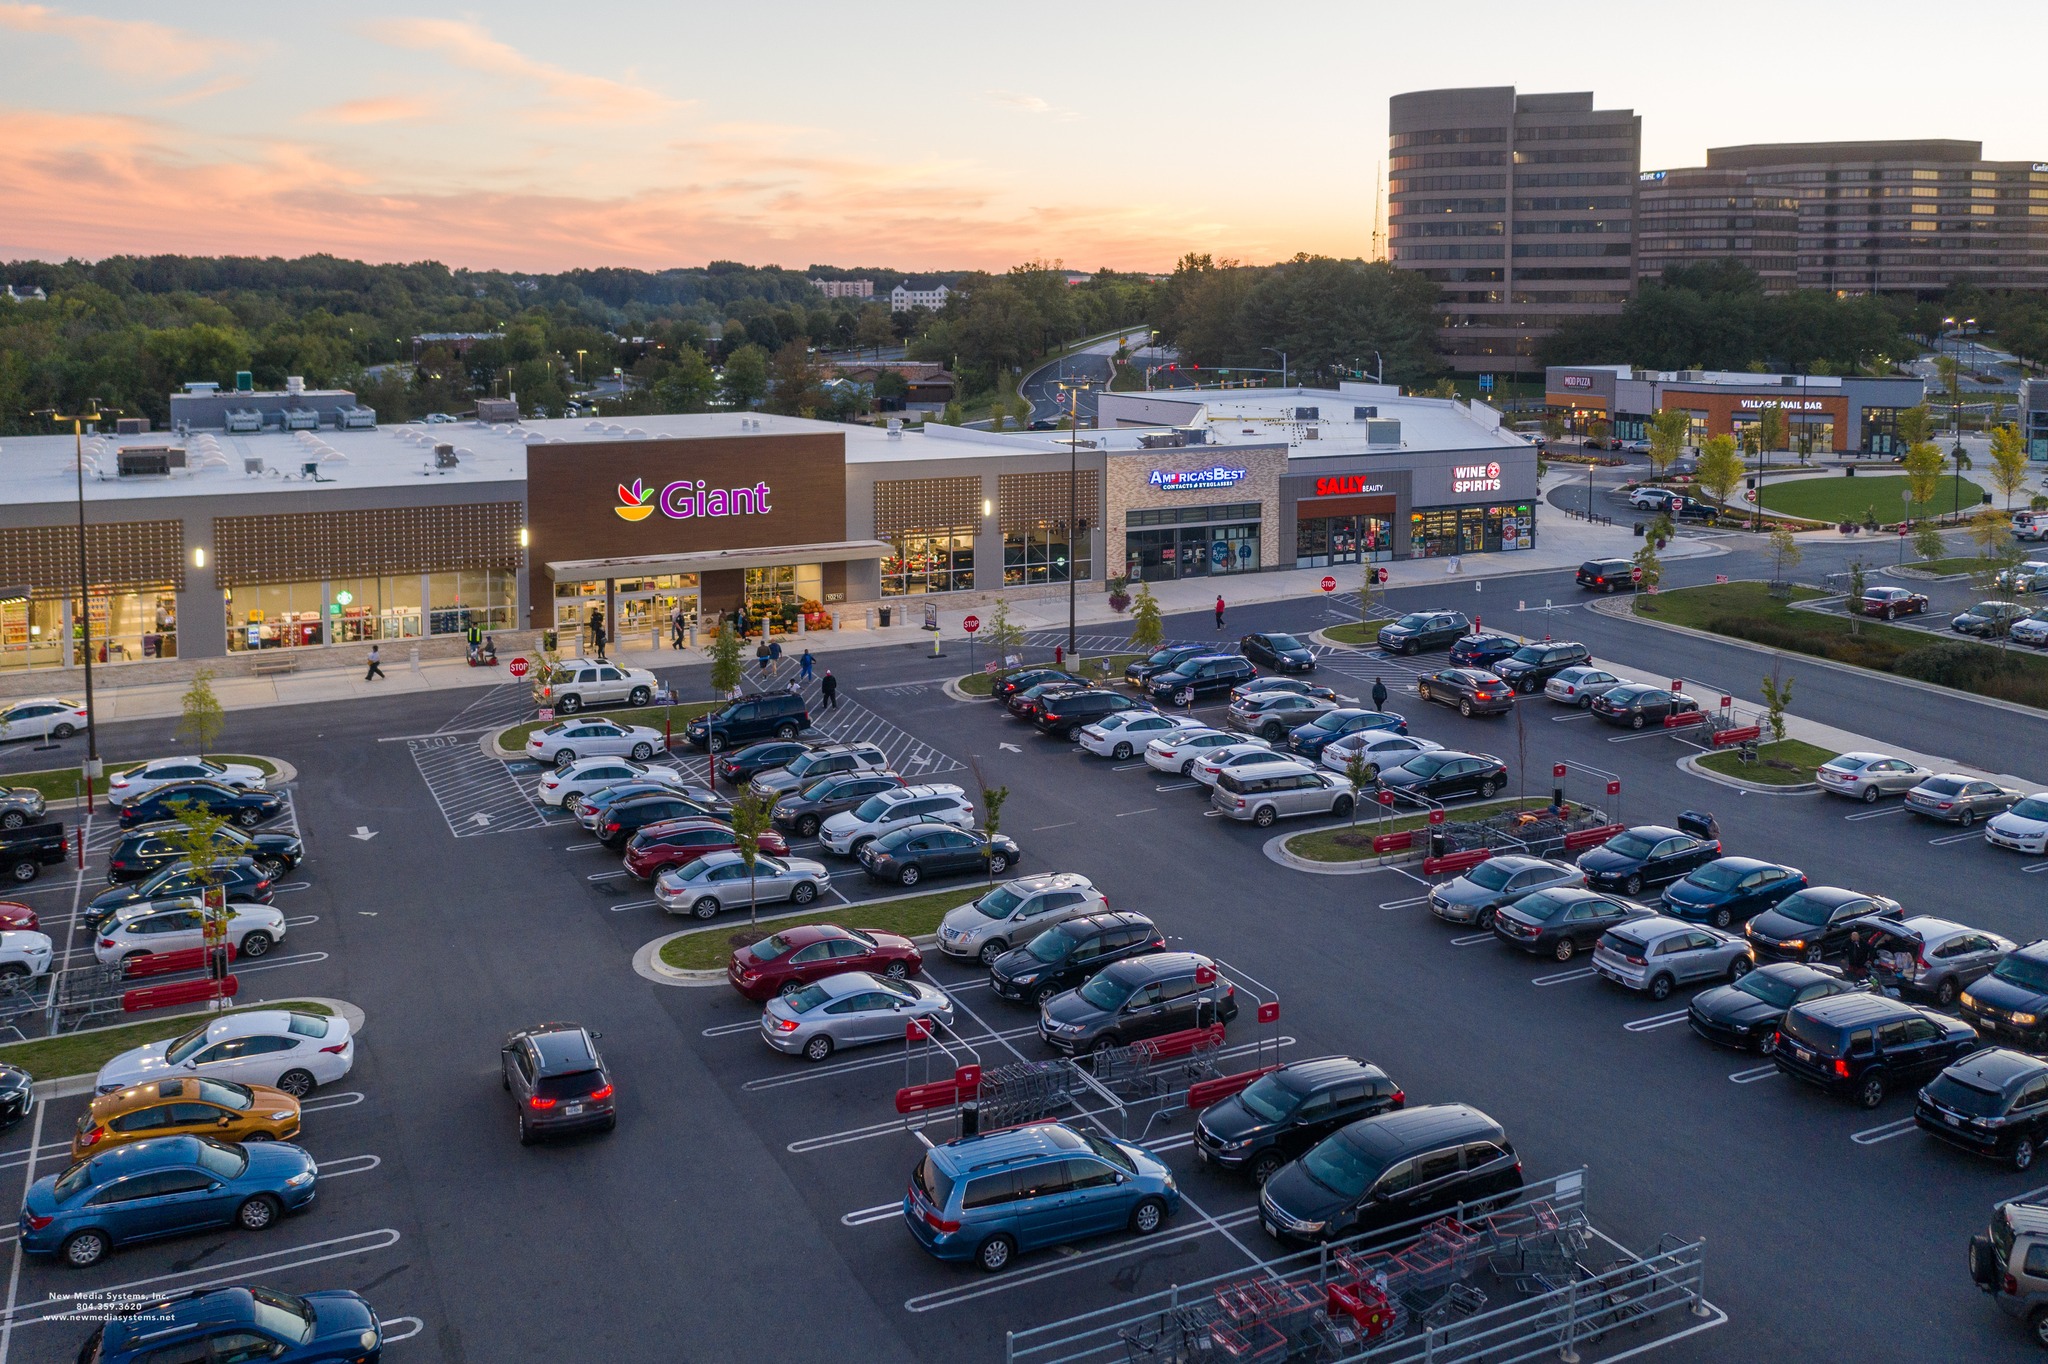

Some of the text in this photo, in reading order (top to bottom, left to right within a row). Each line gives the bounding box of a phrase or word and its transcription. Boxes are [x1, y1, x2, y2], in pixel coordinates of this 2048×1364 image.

[1564, 377, 1576, 386] MOD
[1576, 377, 1591, 387] PIZZA
[1780, 401, 1802, 410] NAIL
[1803, 402, 1823, 410] BAR
[1213, 468, 1245, 481] BEST
[1454, 466, 1486, 478] WINE
[1316, 475, 1383, 496] SALLY BEAUTY
[1453, 479, 1501, 493] SPIRITS
[660, 480, 772, 519] Giant
[510, 663, 528, 672] STOP
[407, 736, 457, 751] STOP
